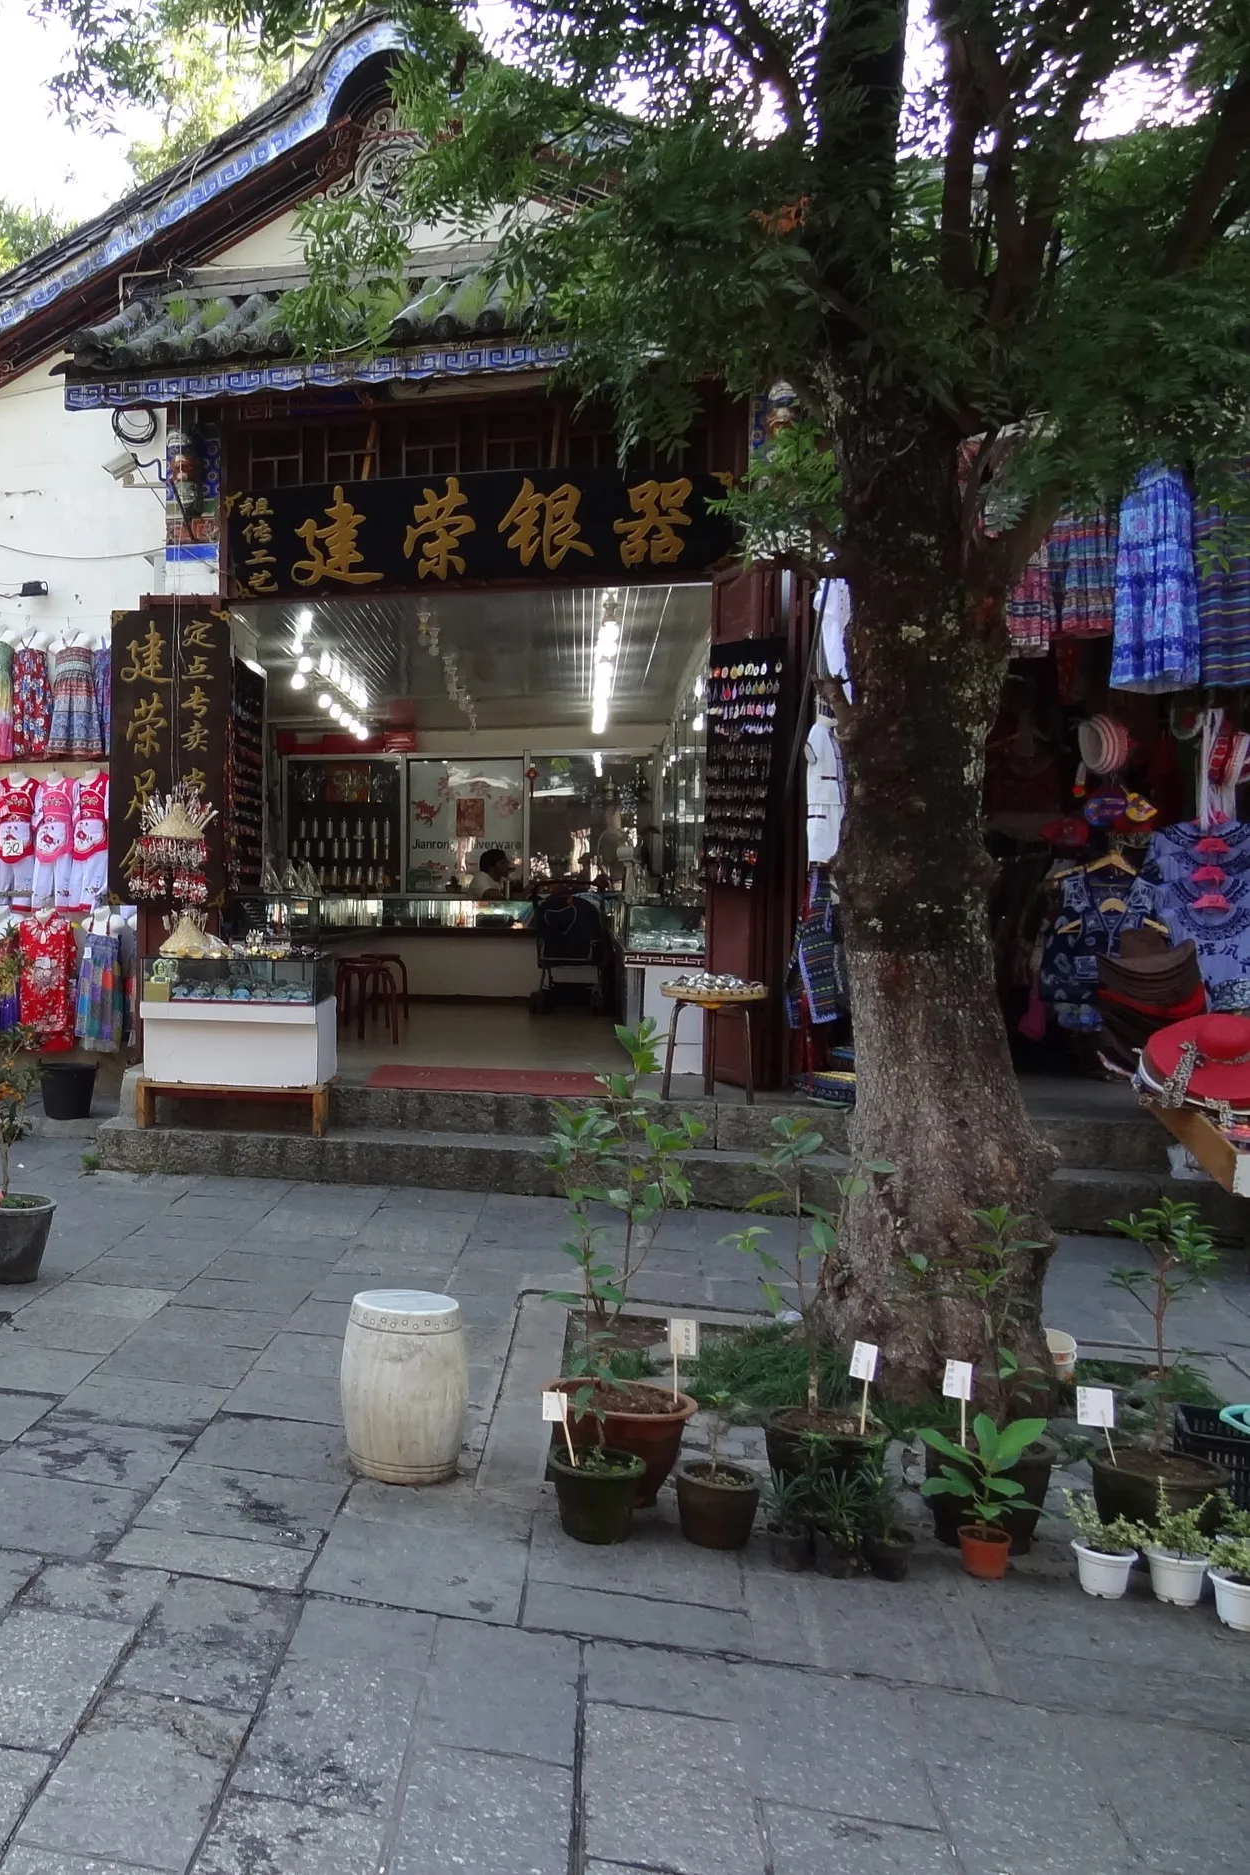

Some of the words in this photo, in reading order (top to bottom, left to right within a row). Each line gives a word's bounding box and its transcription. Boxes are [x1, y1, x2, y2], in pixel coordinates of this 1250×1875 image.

[239, 497, 278, 593] 祖传工艺
[291, 476, 694, 586] 建荣银器
